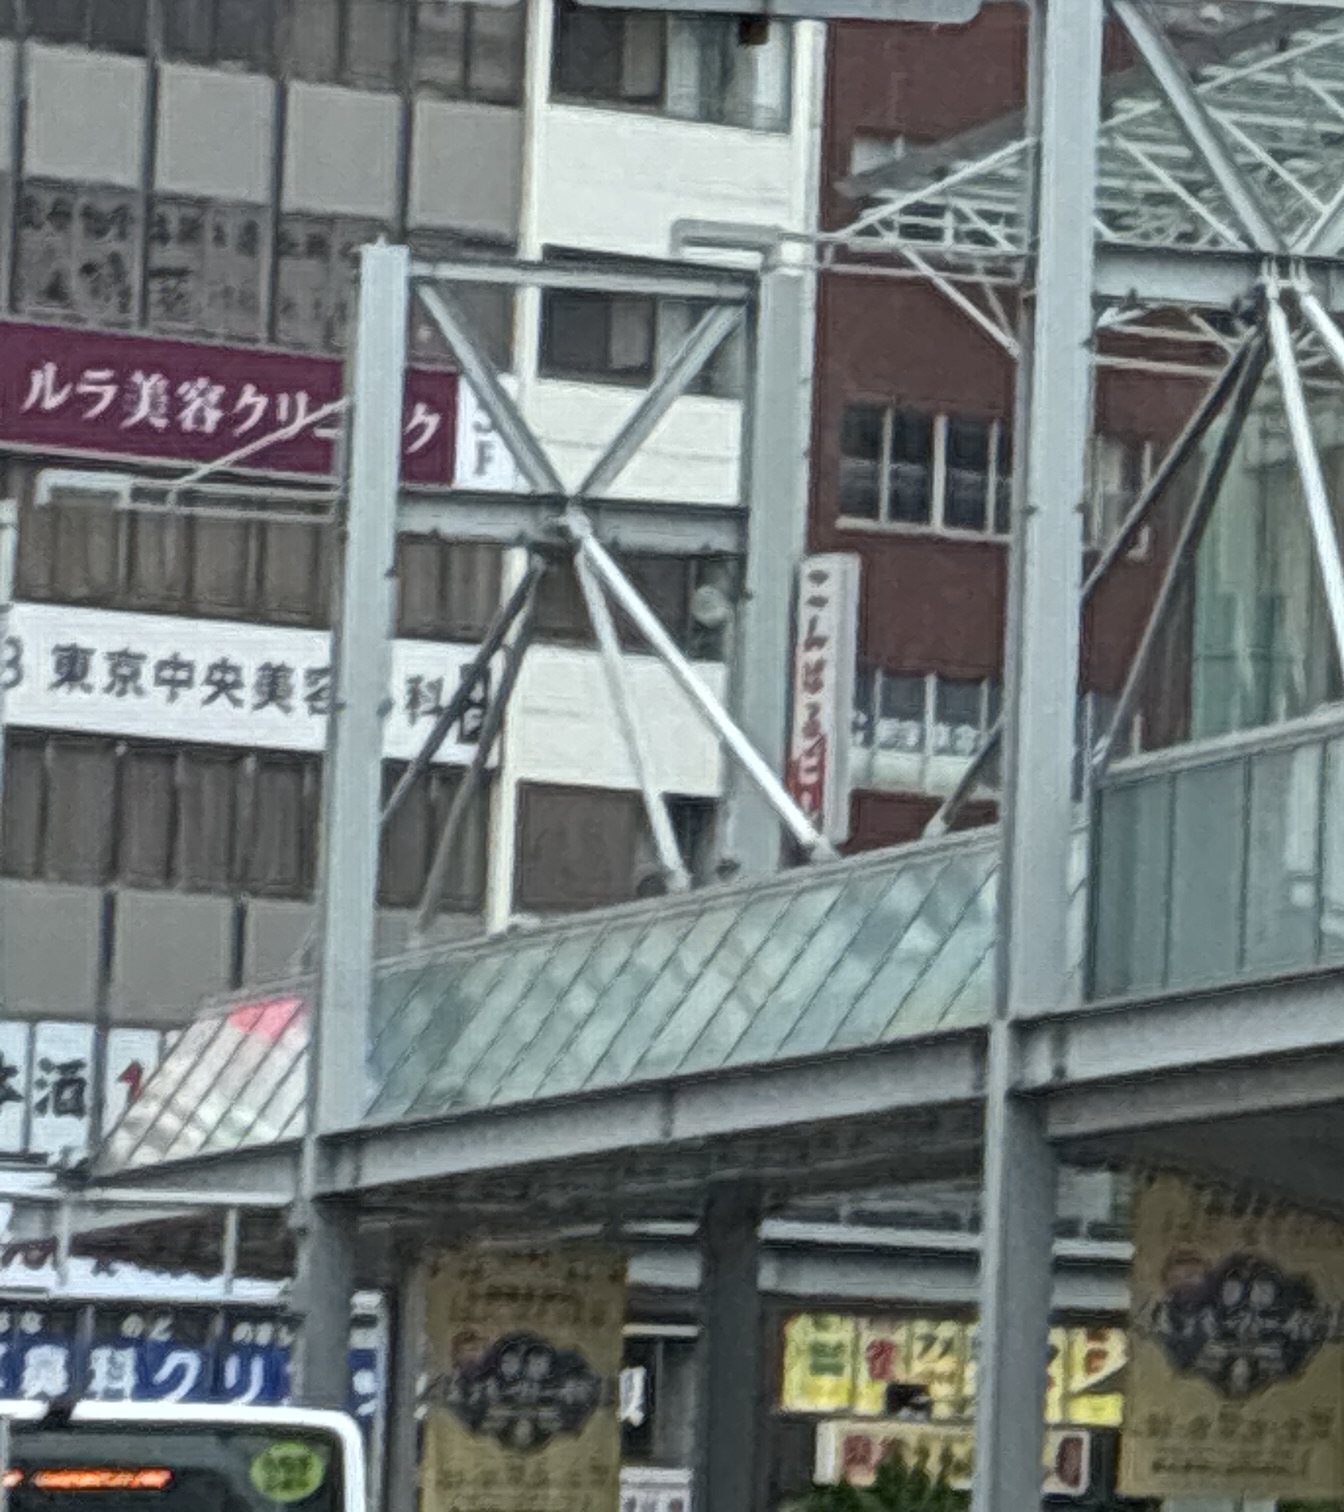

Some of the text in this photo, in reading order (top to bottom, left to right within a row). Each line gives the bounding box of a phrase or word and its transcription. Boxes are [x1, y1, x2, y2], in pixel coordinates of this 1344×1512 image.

[20, 359, 442, 456] ルラ美容クリク
[49, 642, 444, 728] 東京中央美容科
